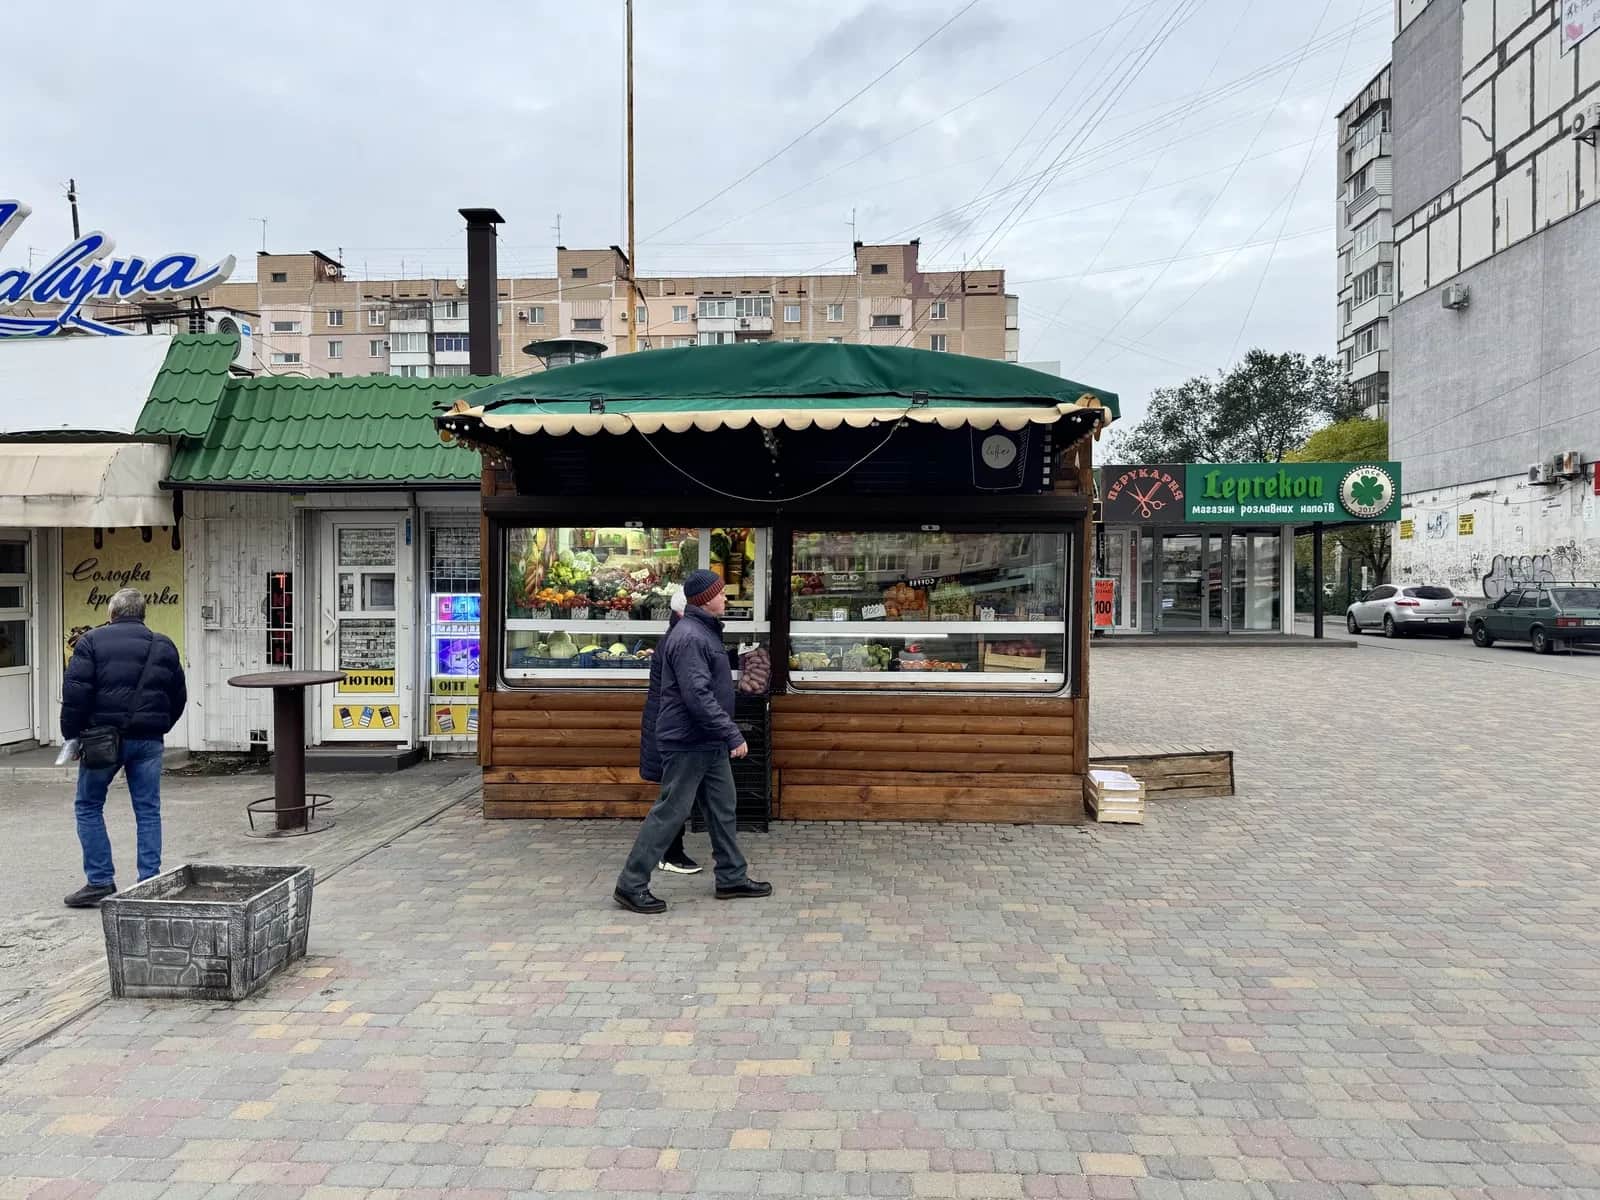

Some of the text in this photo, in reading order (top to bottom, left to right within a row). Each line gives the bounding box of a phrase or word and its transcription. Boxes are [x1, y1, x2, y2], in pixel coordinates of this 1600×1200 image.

[1107, 468, 1184, 501] ПЕРУКАРНЯ
[1202, 468, 1325, 504] Leprekon
[1192, 502, 1336, 517] магазин розливних напоїв
[66, 557, 151, 587] Солодка
[1094, 600, 1112, 614] 100
[439, 681, 466, 691] ОПТ
